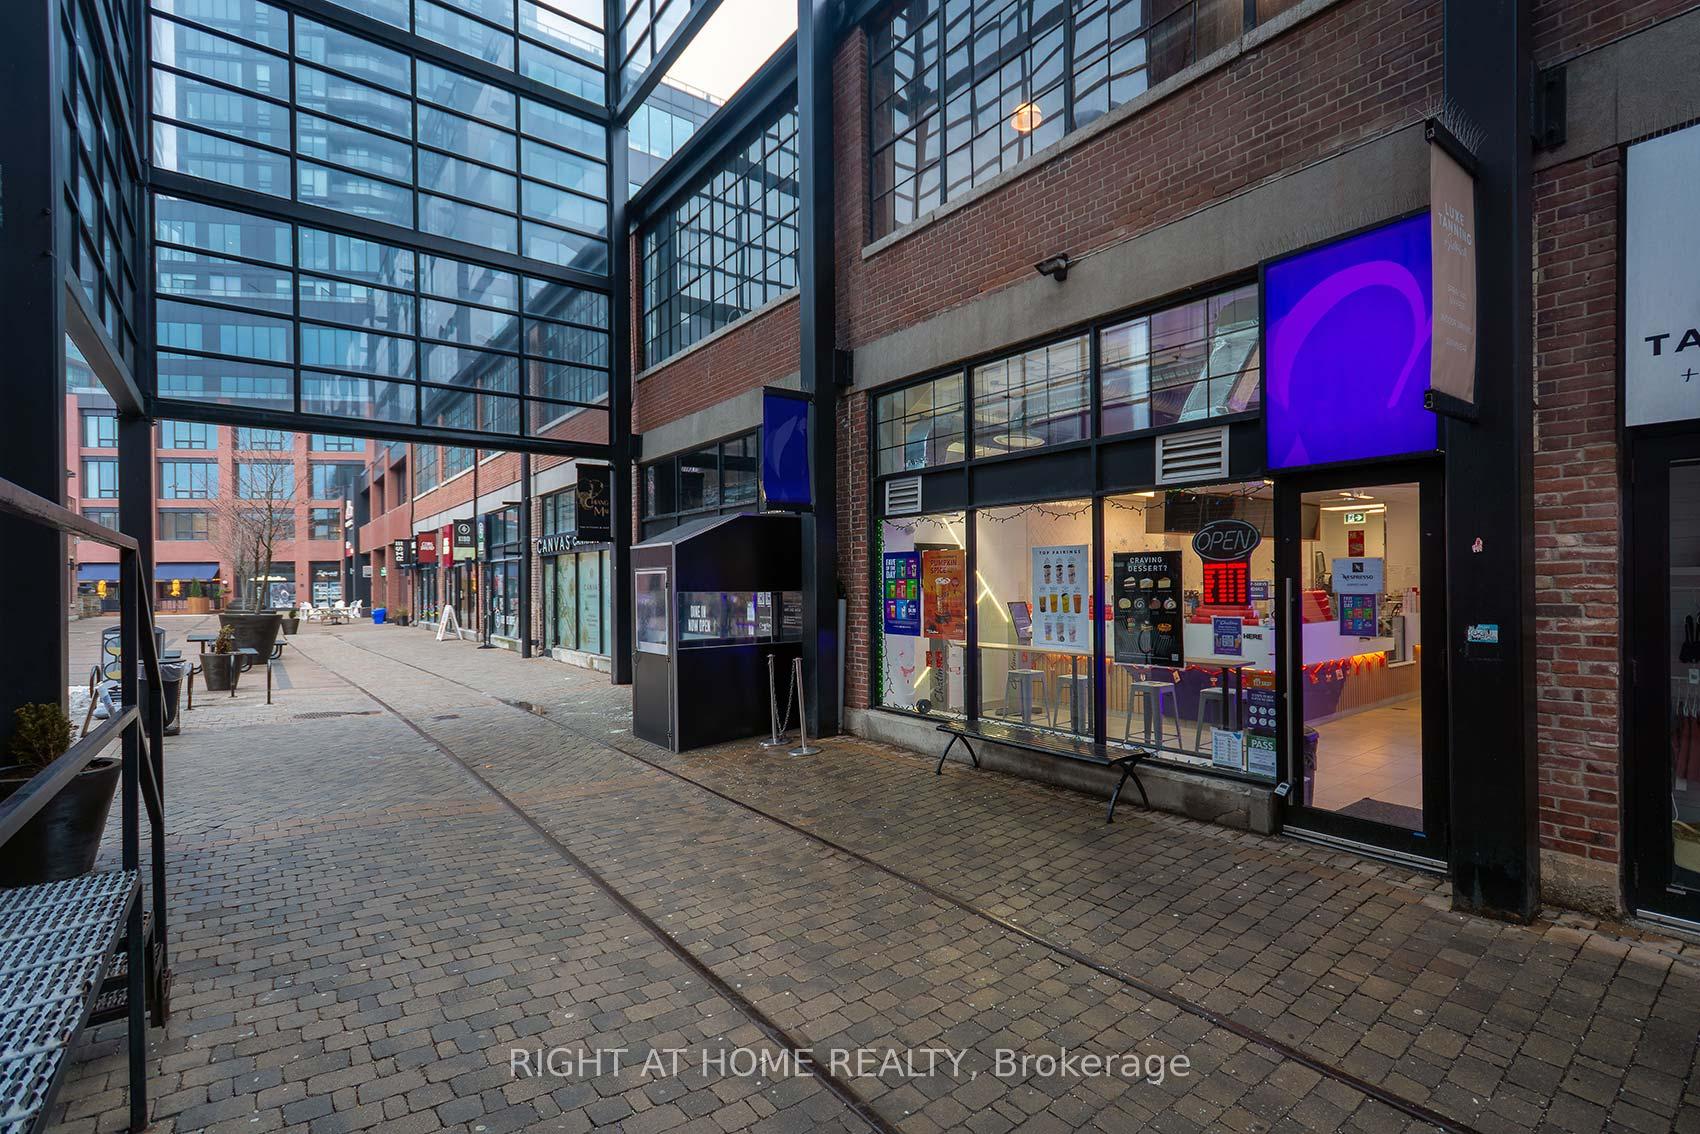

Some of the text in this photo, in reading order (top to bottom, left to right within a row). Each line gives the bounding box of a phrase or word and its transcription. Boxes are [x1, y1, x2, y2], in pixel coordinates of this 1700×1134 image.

[1444, 202, 1464, 226] LUXE
[1437, 212, 1472, 246] TANNING
[536, 535, 570, 553] CANVAS
[1197, 530, 1252, 550] OPEN
[1130, 556, 1162, 564] CRAVING
[1343, 574, 1374, 582] NESPRESSO
[700, 619, 711, 632] OPEN
[1251, 739, 1274, 751] PASS
